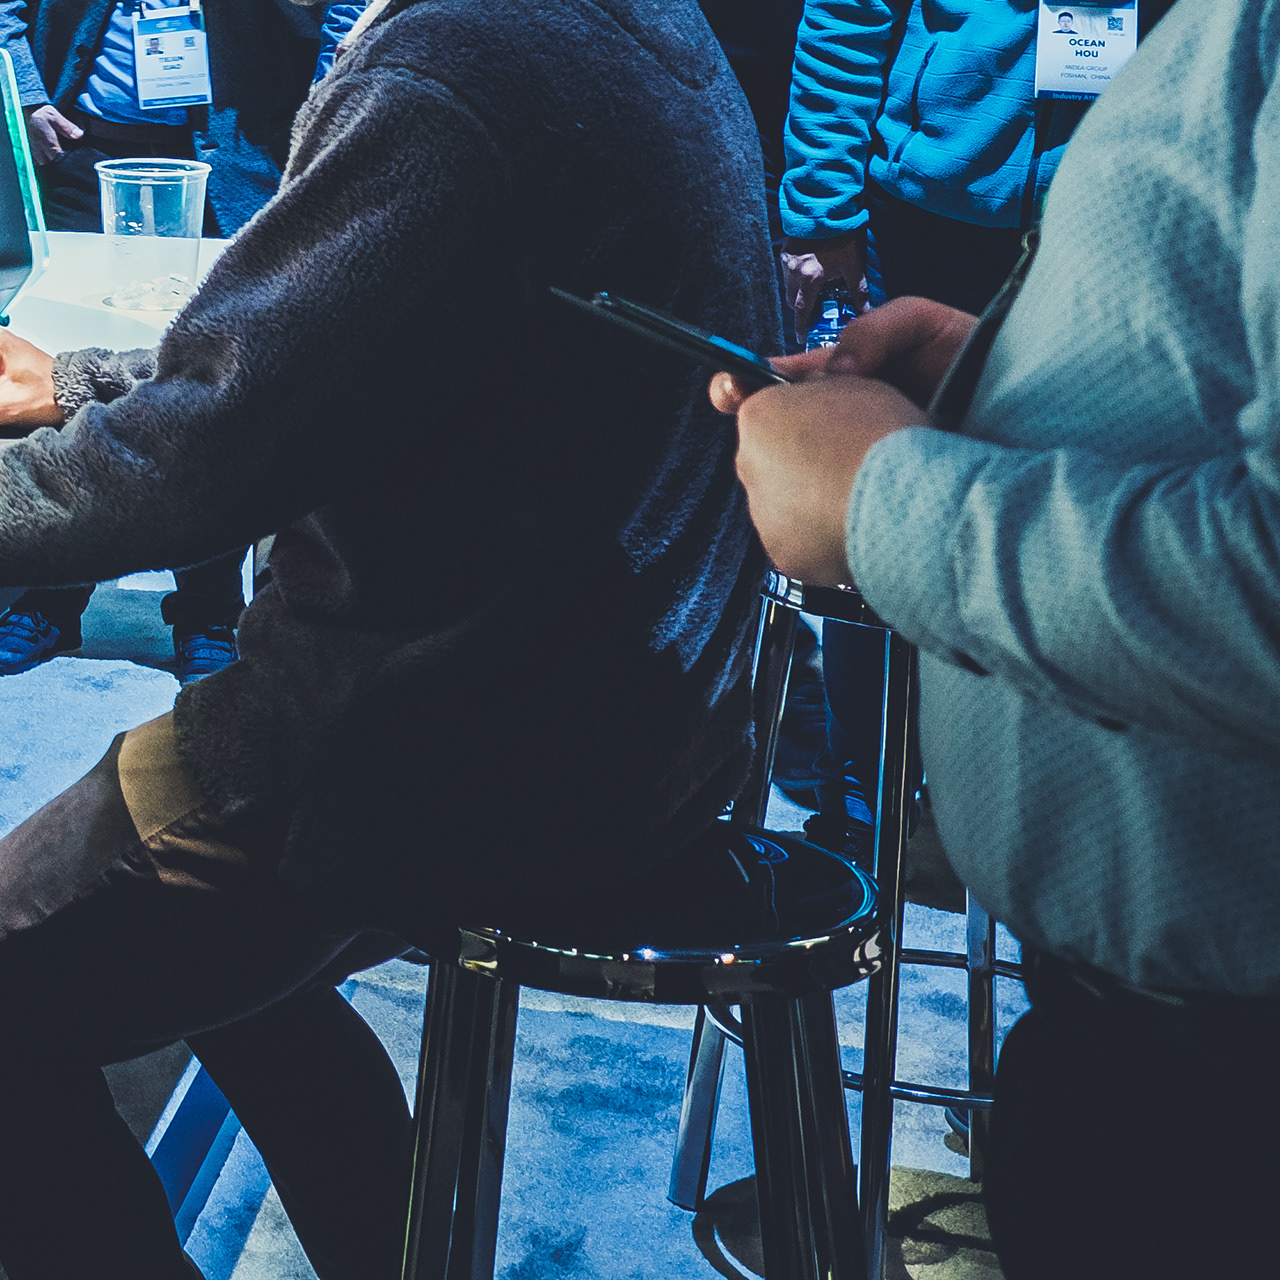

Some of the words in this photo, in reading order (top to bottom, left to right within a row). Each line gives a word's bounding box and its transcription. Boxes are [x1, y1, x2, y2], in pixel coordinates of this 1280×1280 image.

[1068, 38, 1106, 48] OCEAN
[1075, 49, 1099, 58] HOU
[1052, 93, 1082, 101] Industry
